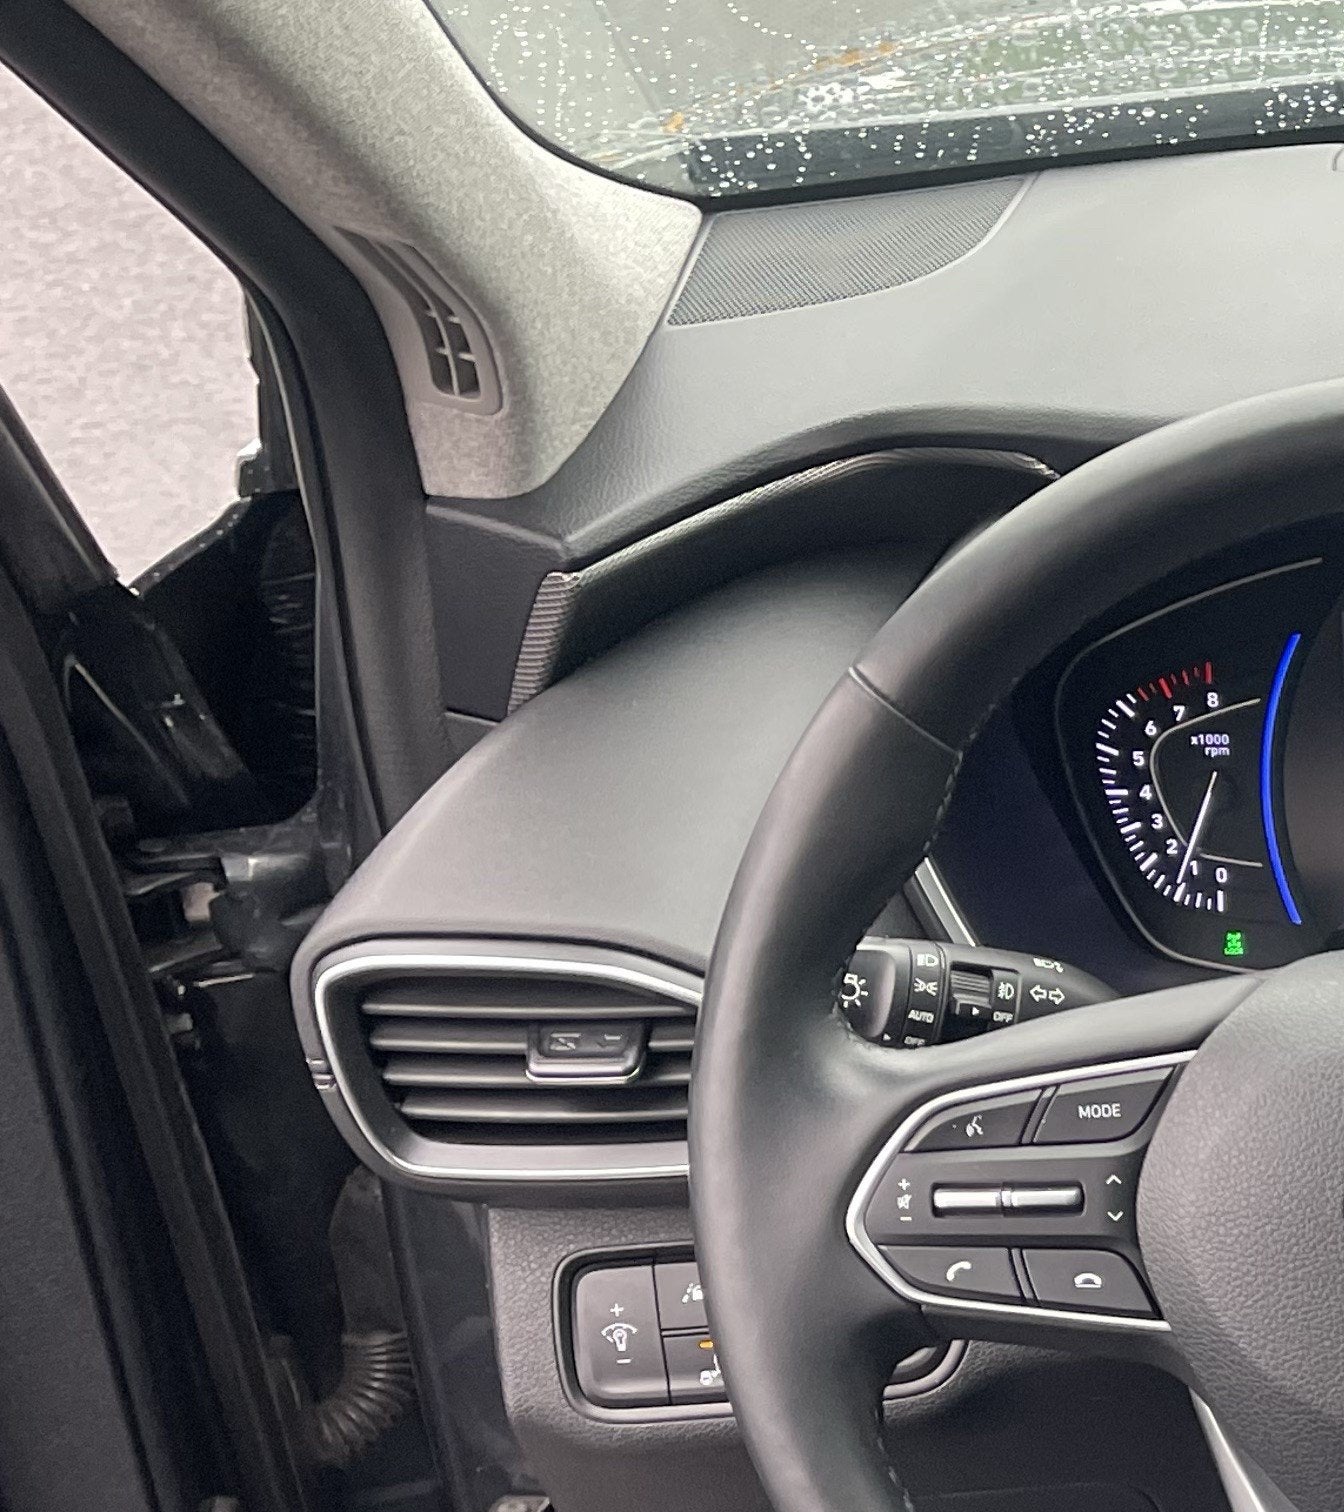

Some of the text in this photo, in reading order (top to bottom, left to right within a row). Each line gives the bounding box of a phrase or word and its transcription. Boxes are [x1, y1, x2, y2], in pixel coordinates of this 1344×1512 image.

[1207, 693, 1218, 707] 8
[1173, 706, 1185, 721] 7
[1145, 721, 1156, 736] 6
[1190, 733, 1230, 746] x1000
[1132, 752, 1144, 766] 5
[1204, 746, 1230, 758] rpm
[1139, 785, 1152, 800] 4
[1152, 814, 1163, 829] 3
[1166, 839, 1178, 854] 2
[1189, 861, 1198, 875] 1
[1216, 868, 1227, 883] 0
[908, 1009, 935, 1024] AUTO
[993, 1011, 1013, 1023] OFF
[1078, 1103, 1122, 1120] MODE
